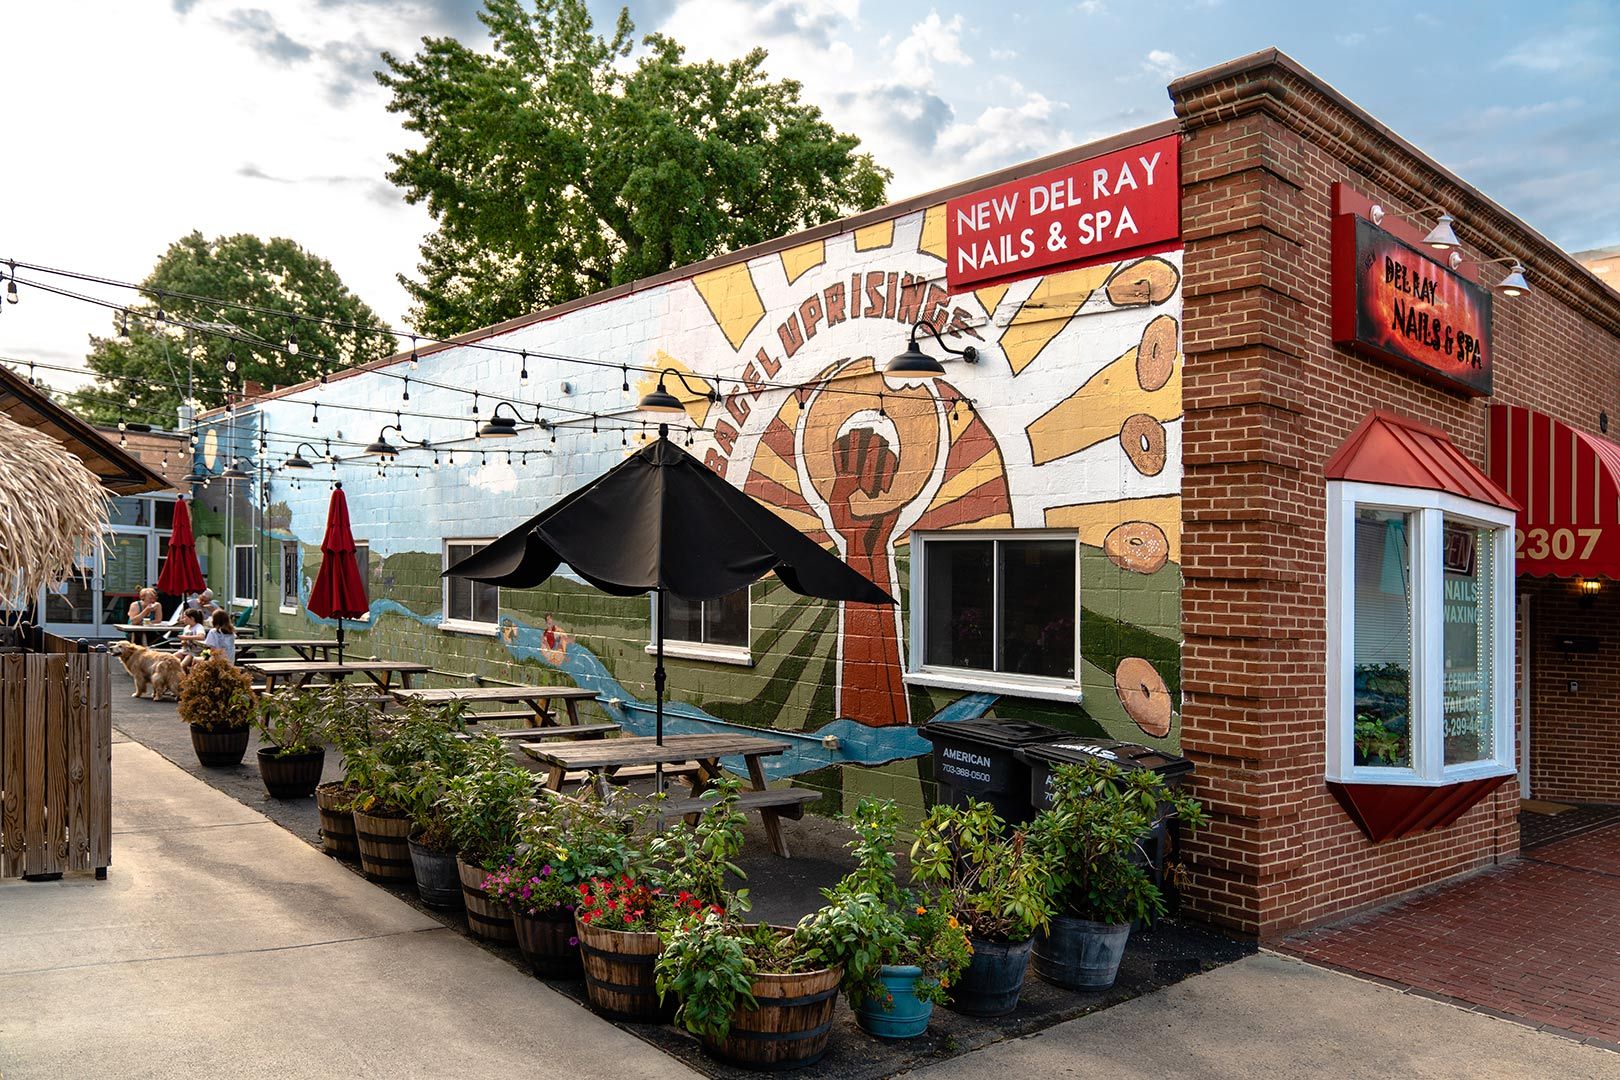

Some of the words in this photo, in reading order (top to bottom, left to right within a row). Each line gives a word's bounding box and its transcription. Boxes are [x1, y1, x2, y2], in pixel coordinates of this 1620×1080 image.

[957, 192, 1019, 236] NEW
[1029, 177, 1082, 217] DEL
[1092, 152, 1162, 200] RAY
[957, 228, 1035, 274] NAILS
[1046, 221, 1068, 252] &
[1078, 205, 1139, 245] SPA
[1385, 255, 1411, 293] DEL
[1412, 271, 1439, 306] RAY
[1392, 298, 1441, 351] NAILS
[1444, 326, 1454, 355] &
[1456, 331, 1483, 369] SPA
[704, 347, 783, 480] BAGEL
[1515, 528, 1603, 560] 2307
[1444, 580, 1478, 602] NAILS
[943, 748, 991, 768] AMERICAN
